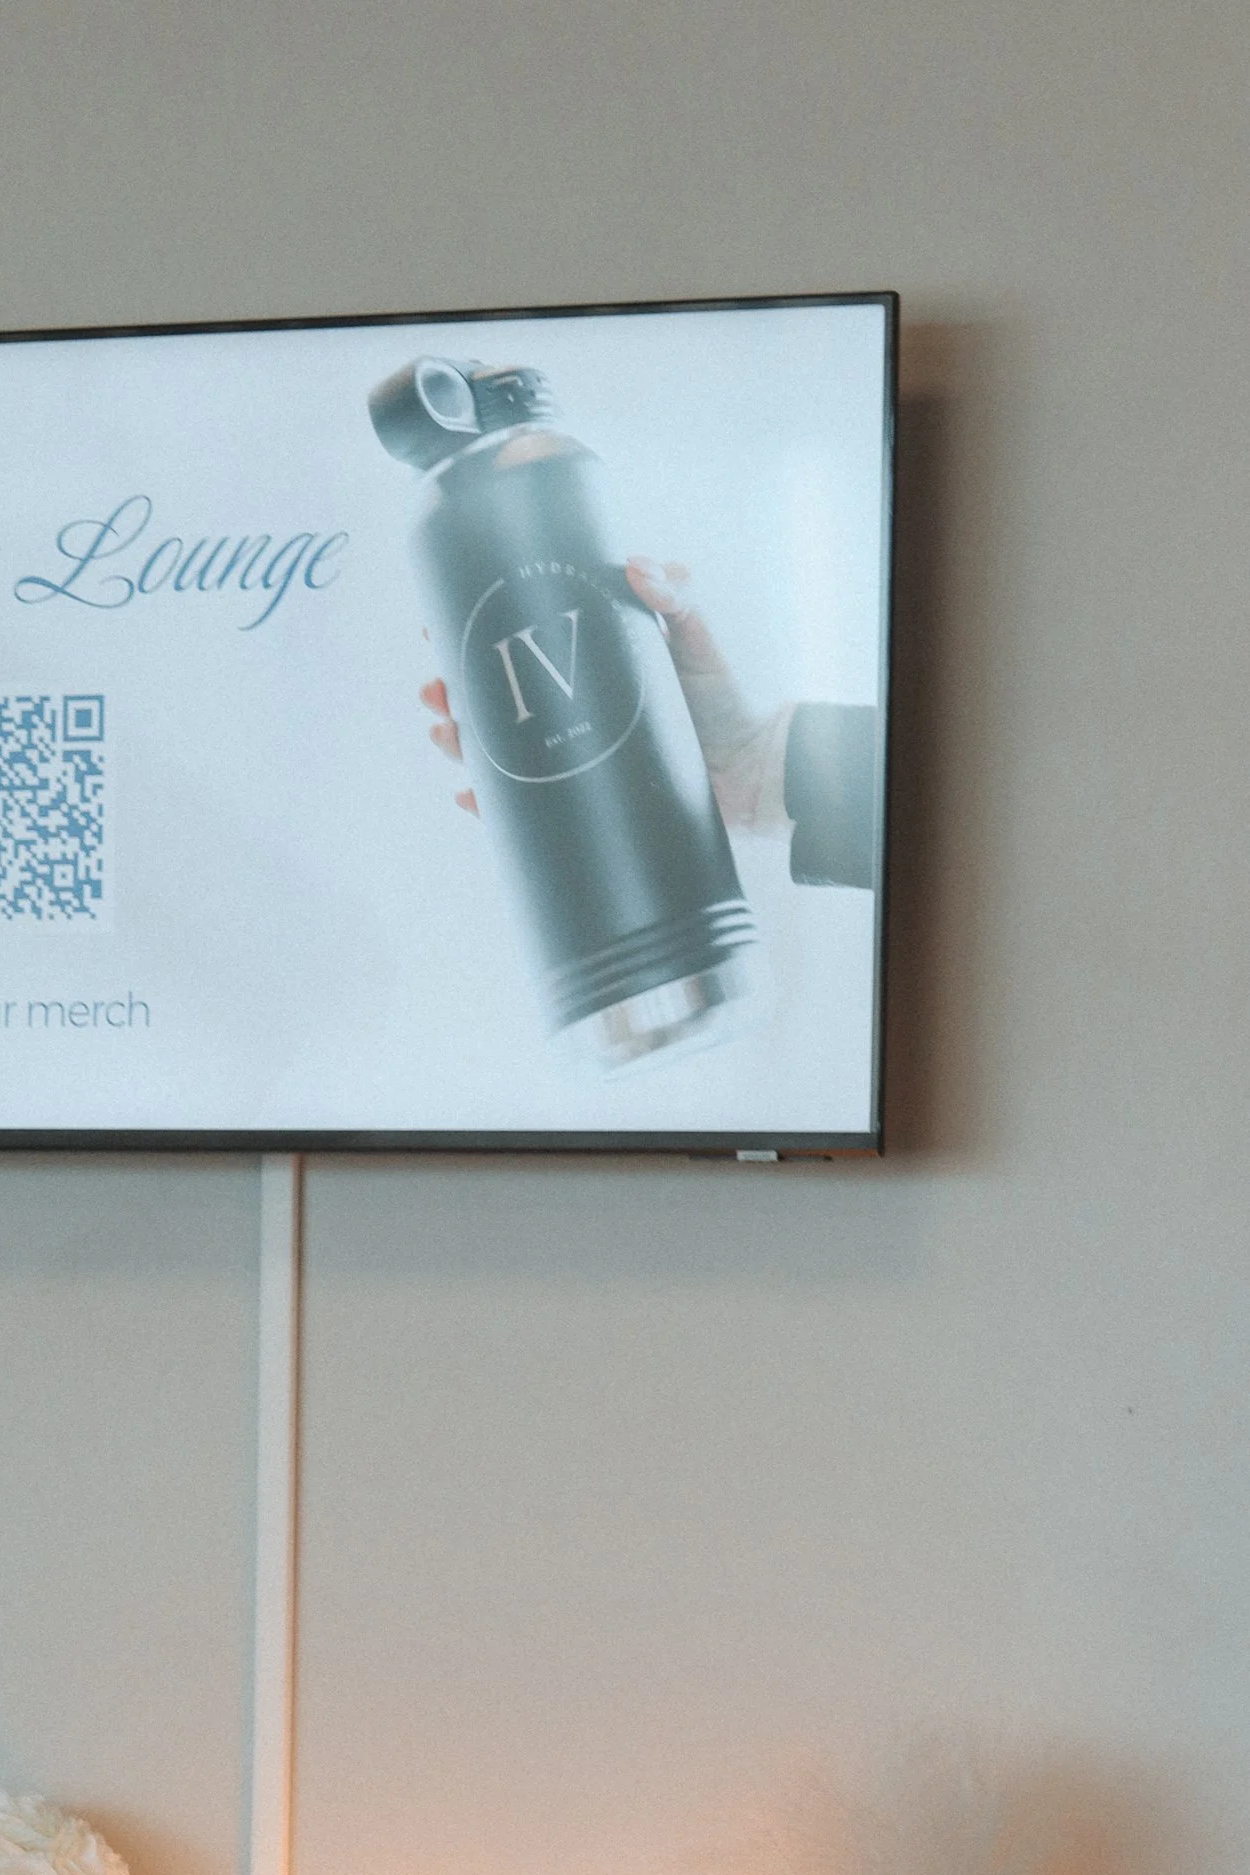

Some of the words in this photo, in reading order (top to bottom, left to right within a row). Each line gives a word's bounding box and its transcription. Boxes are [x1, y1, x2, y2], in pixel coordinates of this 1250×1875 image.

[13, 494, 350, 632] Lounge
[493, 608, 580, 725] IV
[27, 990, 151, 1029] merch
